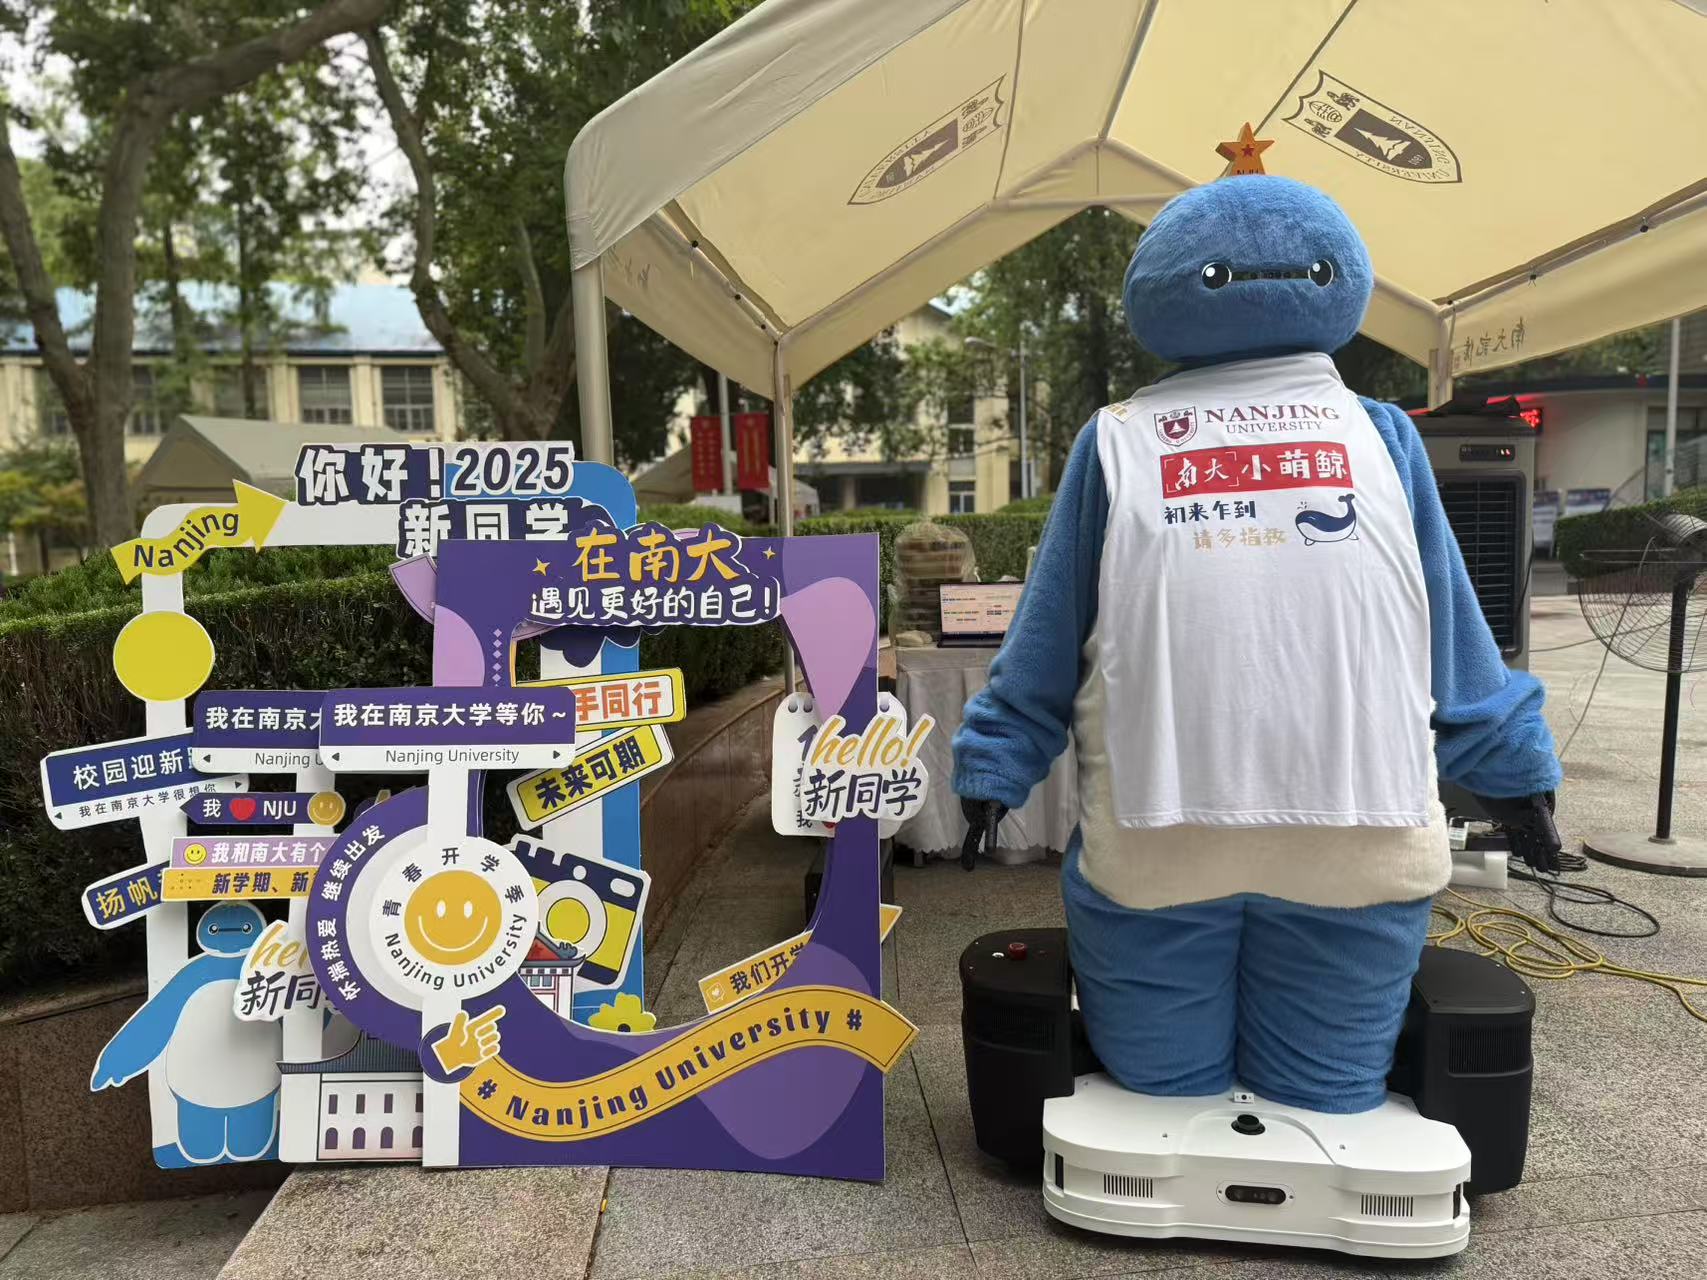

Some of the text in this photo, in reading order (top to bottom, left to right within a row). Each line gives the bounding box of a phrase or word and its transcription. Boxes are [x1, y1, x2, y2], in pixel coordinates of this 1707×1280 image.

[1204, 404, 1340, 423] NANJING
[1225, 421, 1323, 434] UNIVERSITY
[404, 503, 569, 557] 新同学
[1164, 500, 1257, 524] 初来乍到
[133, 510, 240, 569] Nanjing
[572, 528, 741, 583] 在南大
[531, 584, 773, 619] 遇见更好的自己！
[576, 681, 662, 721] 手同行
[255, 752, 310, 769] Nanjing
[386, 747, 520, 767] Nanjing University
[811, 717, 931, 769] hello!
[73, 746, 193, 790] 校园迎新
[535, 736, 646, 811] 未来可期
[78, 783, 217, 818] 我在南京大学很想你
[203, 798, 297, 820] 我 NJU
[804, 766, 923, 819] 新同学
[211, 842, 326, 863] 我和南大有个
[95, 870, 162, 919] 扬帆
[212, 871, 317, 895] 新学期、新
[385, 914, 527, 990] Nanjing University
[505, 1085, 648, 1129] Nanjing
[655, 1006, 831, 1091] University
